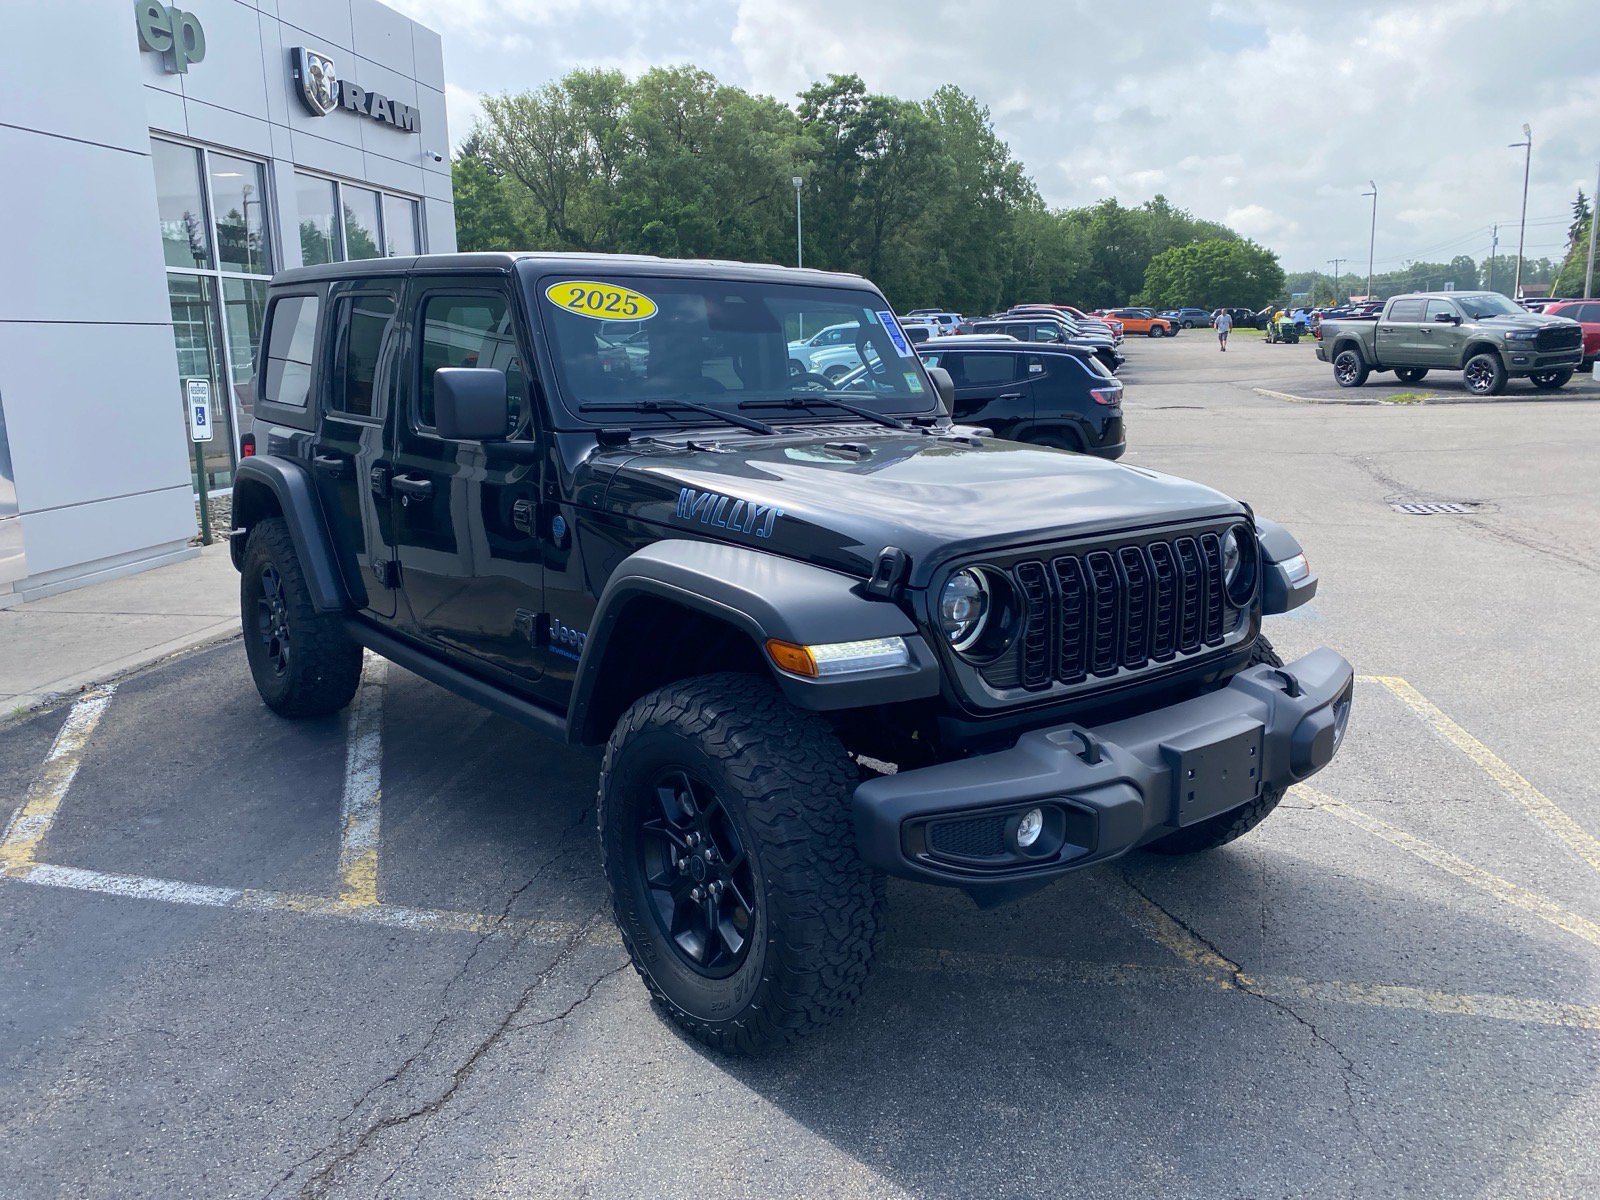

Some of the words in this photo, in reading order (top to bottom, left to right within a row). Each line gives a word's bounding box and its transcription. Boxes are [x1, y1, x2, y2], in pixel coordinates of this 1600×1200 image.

[338, 79, 420, 134] RAM
[567, 288, 639, 316] 2025
[676, 487, 785, 539] WILLYS
[549, 618, 587, 652] Jeep
